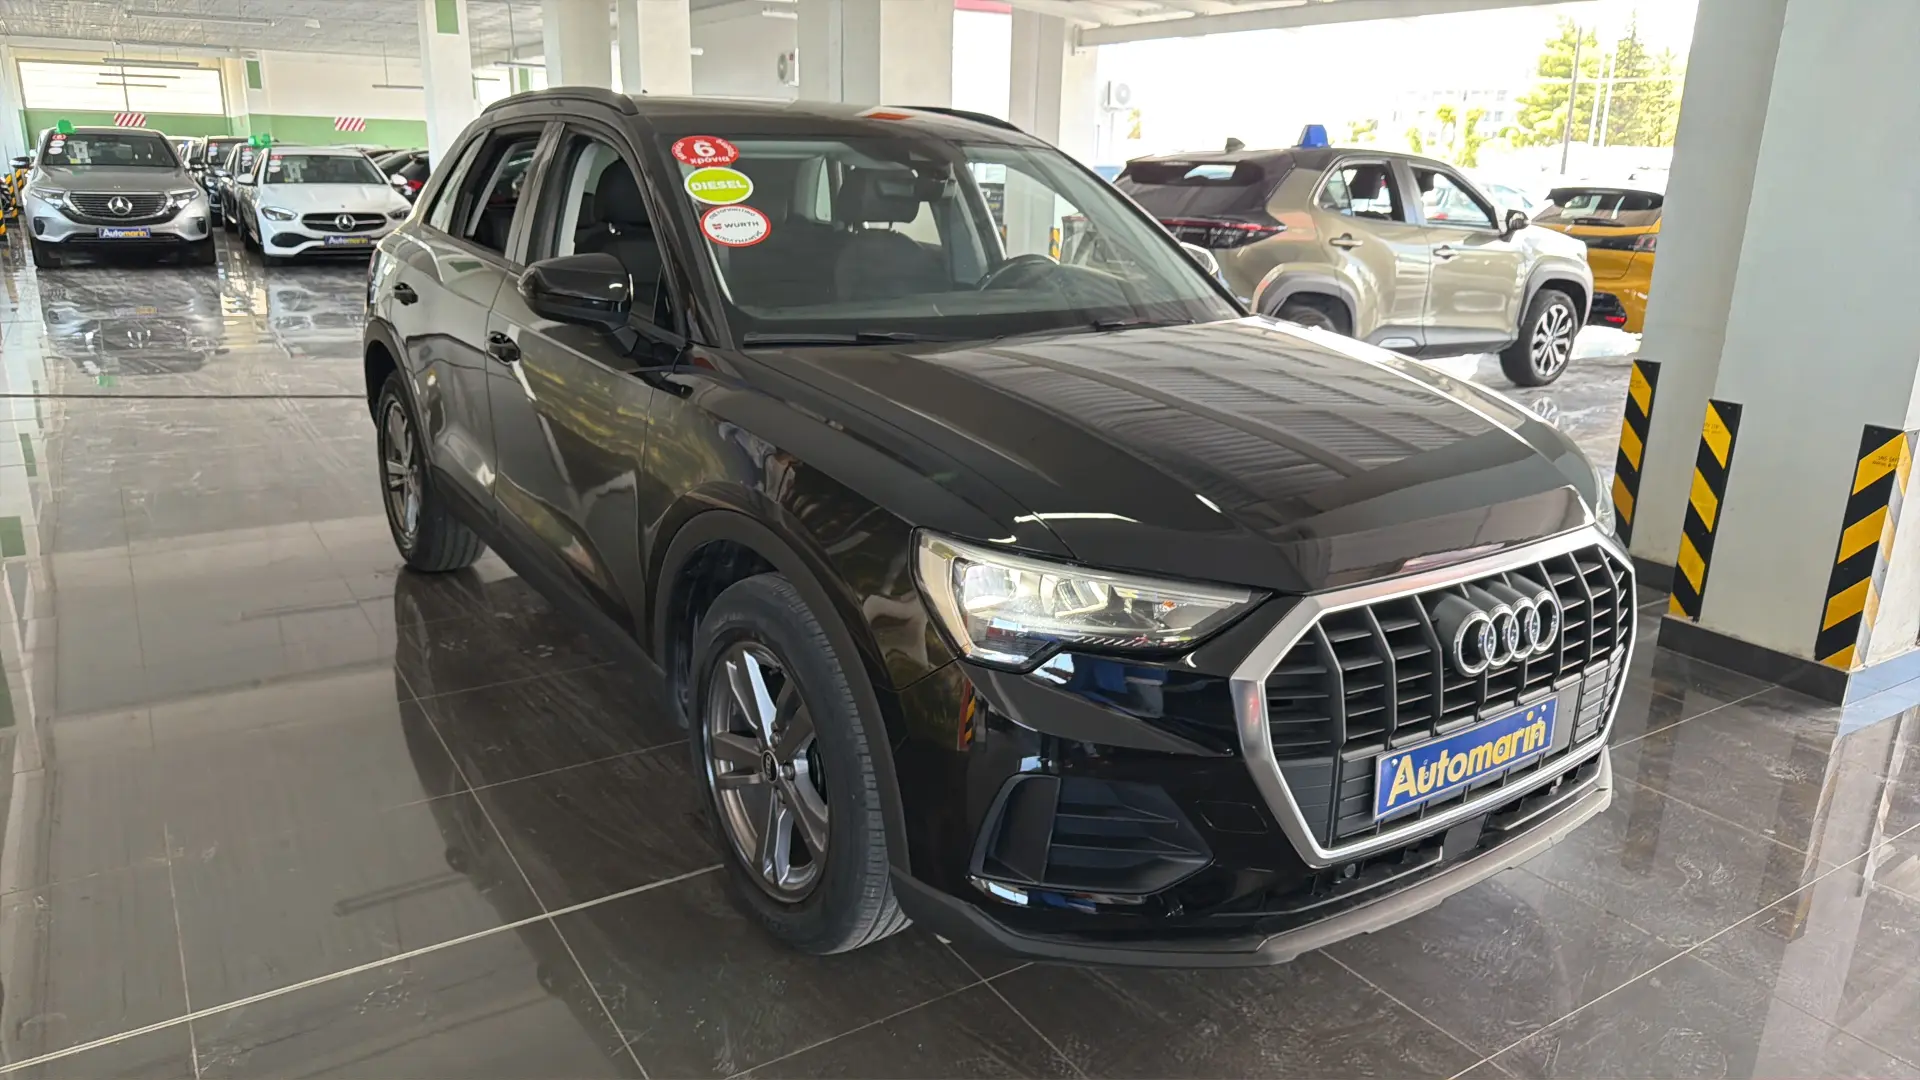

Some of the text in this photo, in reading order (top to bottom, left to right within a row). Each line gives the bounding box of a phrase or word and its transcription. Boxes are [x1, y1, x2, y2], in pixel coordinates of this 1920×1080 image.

[693, 141, 716, 157] 6
[690, 180, 748, 191] DIESEL
[102, 228, 147, 238] Automarin
[1386, 711, 1546, 807] Automarin
